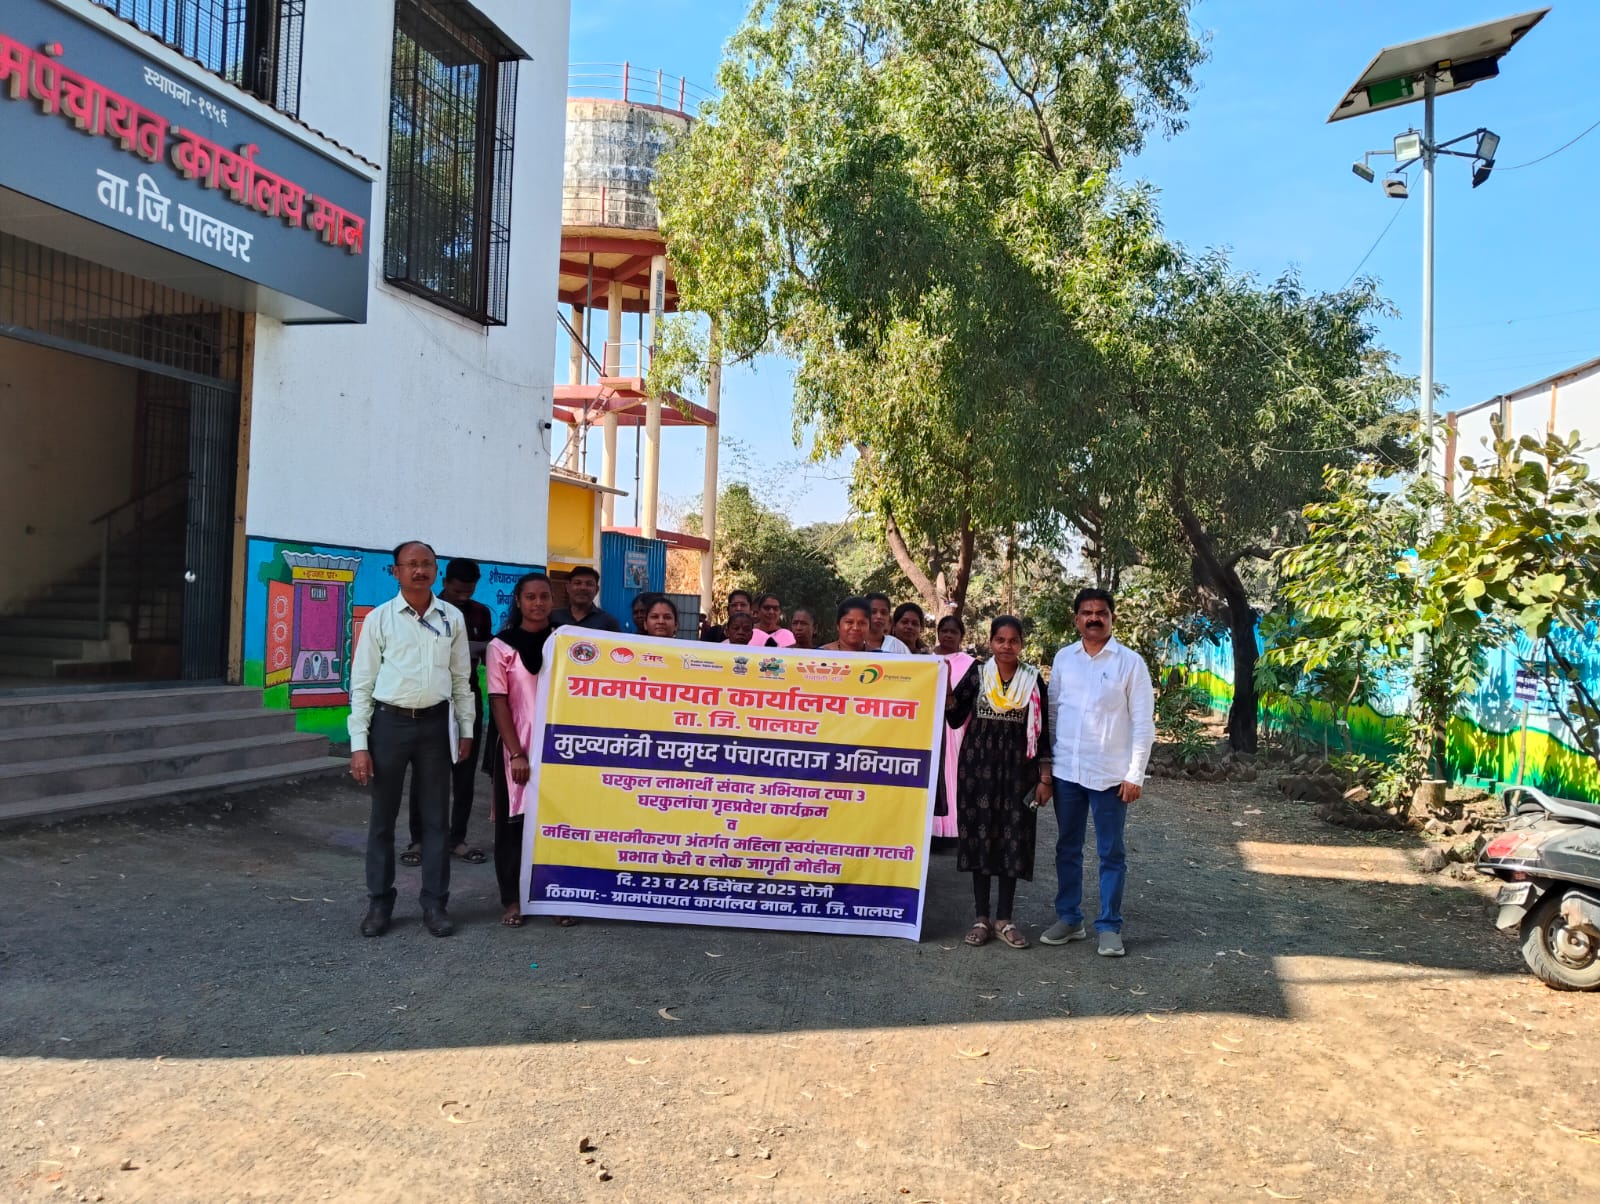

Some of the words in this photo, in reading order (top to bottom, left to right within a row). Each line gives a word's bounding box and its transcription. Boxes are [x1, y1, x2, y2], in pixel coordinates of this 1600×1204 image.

[172, 125, 307, 227] कार्यालय
[306, 193, 365, 254] मान
[178, 203, 254, 262] पालघर
[567, 676, 723, 706] ग्रामपंचायत
[727, 686, 849, 714] कार्यालय
[854, 697, 919, 720] मान
[673, 712, 703, 727] ता.
[709, 711, 741, 730] जि.
[747, 716, 819, 735] पालघर
[554, 733, 653, 760] मुख्यमंत्री
[723, 740, 830, 770] पंचायतराज
[834, 749, 921, 777] अभियान
[602, 774, 651, 790] घरकुल
[655, 776, 714, 792] लाभार्थी
[716, 778, 755, 794] संवाद
[759, 781, 821, 800] अभियान
[824, 788, 853, 801] टप्पा
[638, 795, 708, 812] घरकुलांचा
[711, 799, 766, 816] गृहप्रवेश
[770, 802, 829, 818] कार्यक्रम
[726, 818, 738, 831] व
[542, 824, 591, 842] महिला
[594, 829, 681, 847] सक्षमीकरण
[685, 832, 729, 850] अंतर्गत
[733, 836, 780, 853] महिला
[785, 840, 871, 859] स्वयंसहायता
[873, 845, 914, 861] गटाची
[618, 850, 659, 864] प्रभात
[662, 850, 692, 867] फेरी
[695, 854, 706, 867] व
[709, 853, 743, 868] लोक
[746, 856, 791, 876] जागृती
[794, 857, 842, 875] मोहीम
[616, 872, 636, 887] दि.
[641, 876, 661, 888] 23
[664, 878, 677, 889] व
[679, 879, 700, 890] 24
[703, 877, 754, 894] डिसेंबर
[757, 882, 797, 896] 2025
[800, 883, 835, 898] रोजी
[611, 890, 691, 907] ग्रामपंचायत
[694, 895, 758, 911] कार्यालय
[760, 900, 797, 914] मान,
[852, 905, 904, 919] पालघर
